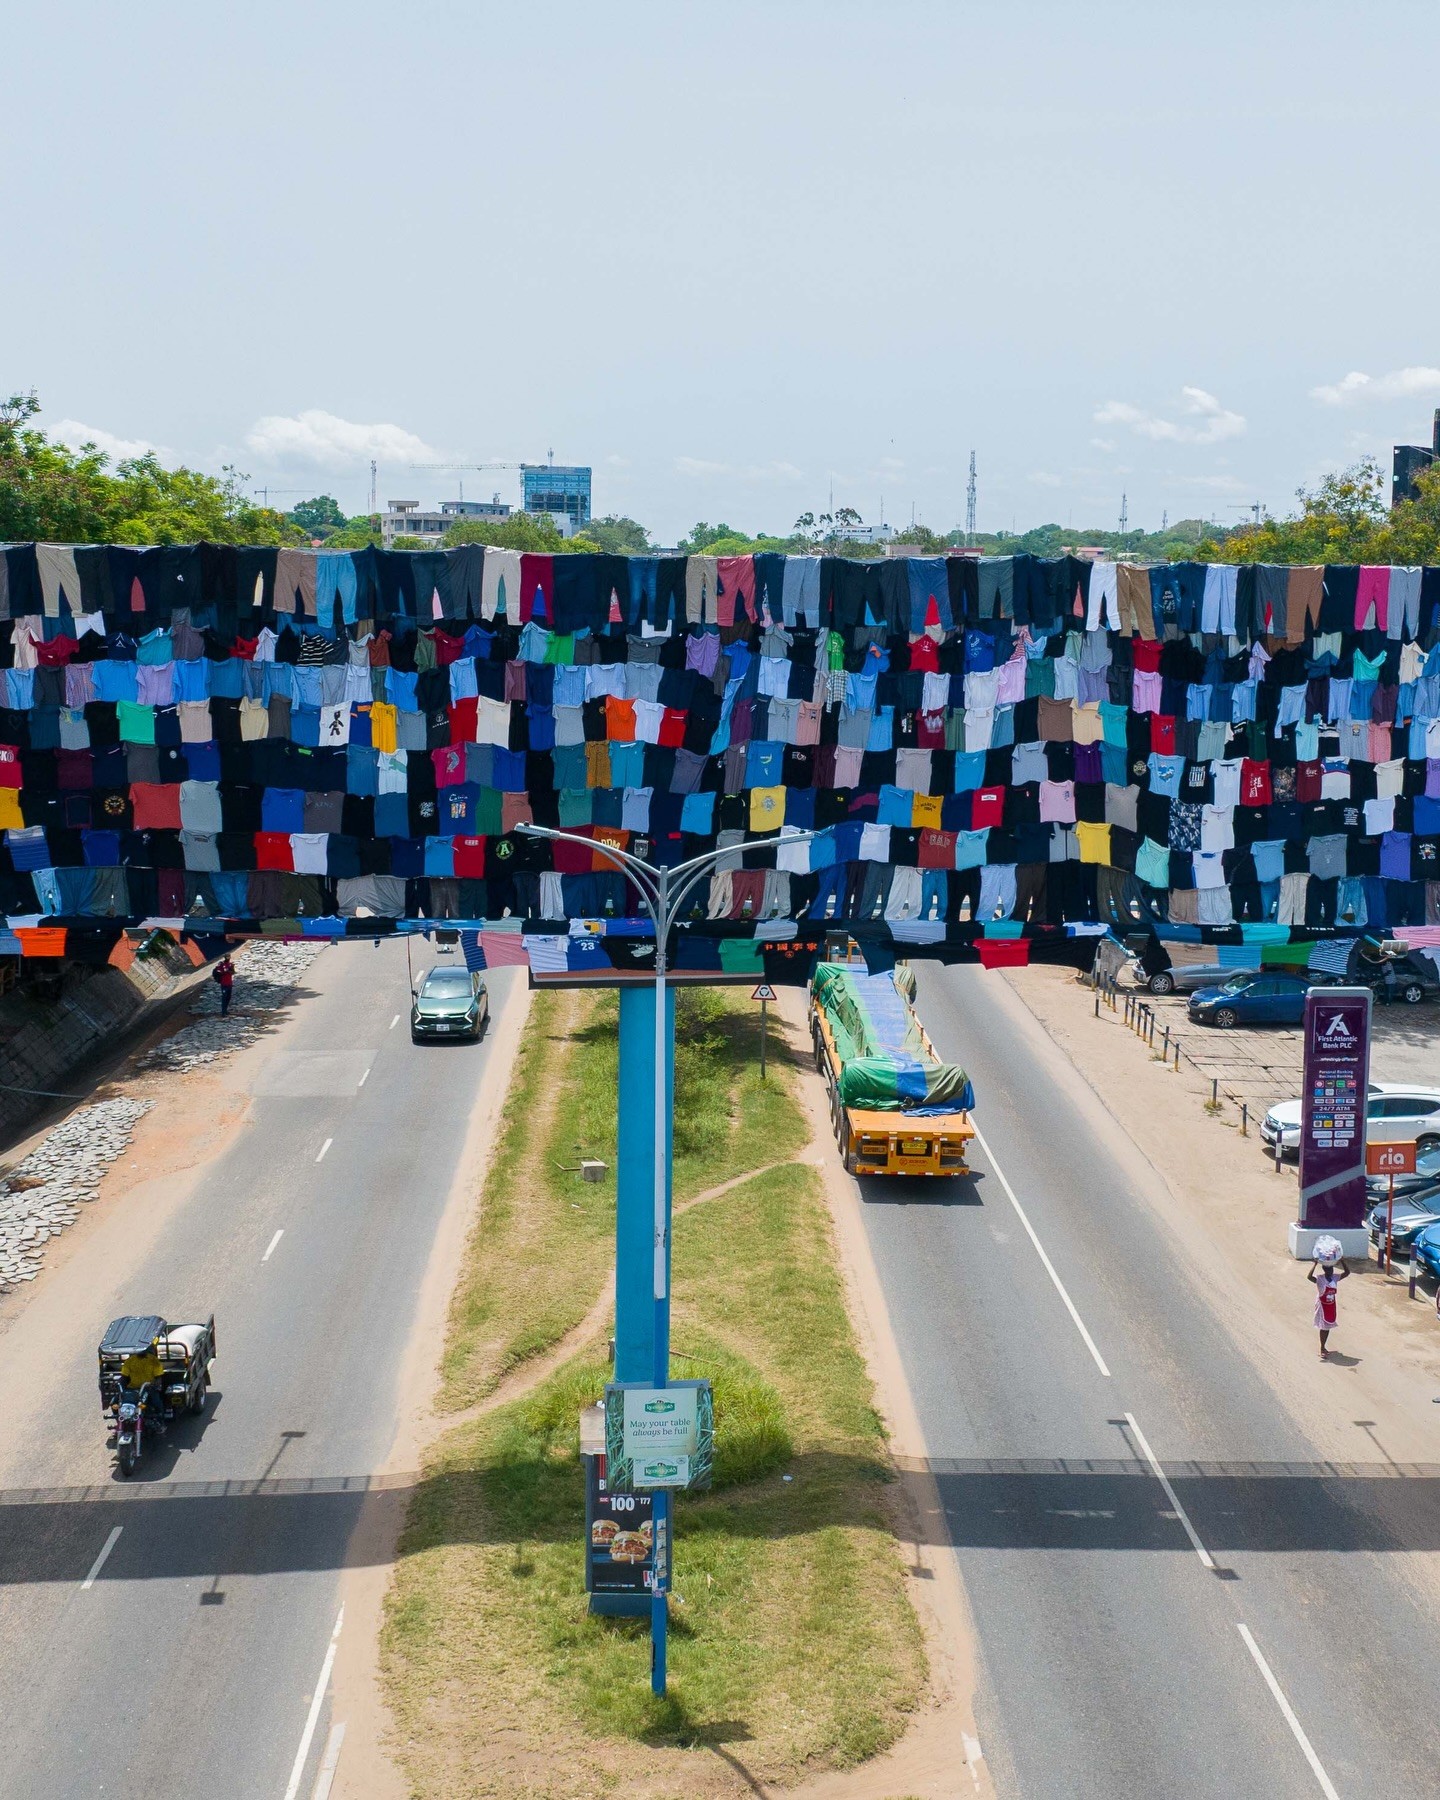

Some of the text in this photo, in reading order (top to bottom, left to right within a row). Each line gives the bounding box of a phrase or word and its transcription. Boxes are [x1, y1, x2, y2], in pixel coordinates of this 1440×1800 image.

[581, 942, 595, 951] 23
[1380, 1147, 1405, 1165] ria
[630, 1418, 691, 1429] May your table
[632, 1429, 661, 1437] always
[674, 1427, 688, 1435] full
[599, 1479, 607, 1490] B
[610, 1497, 635, 1511] 100
[640, 1497, 651, 1505] 177
